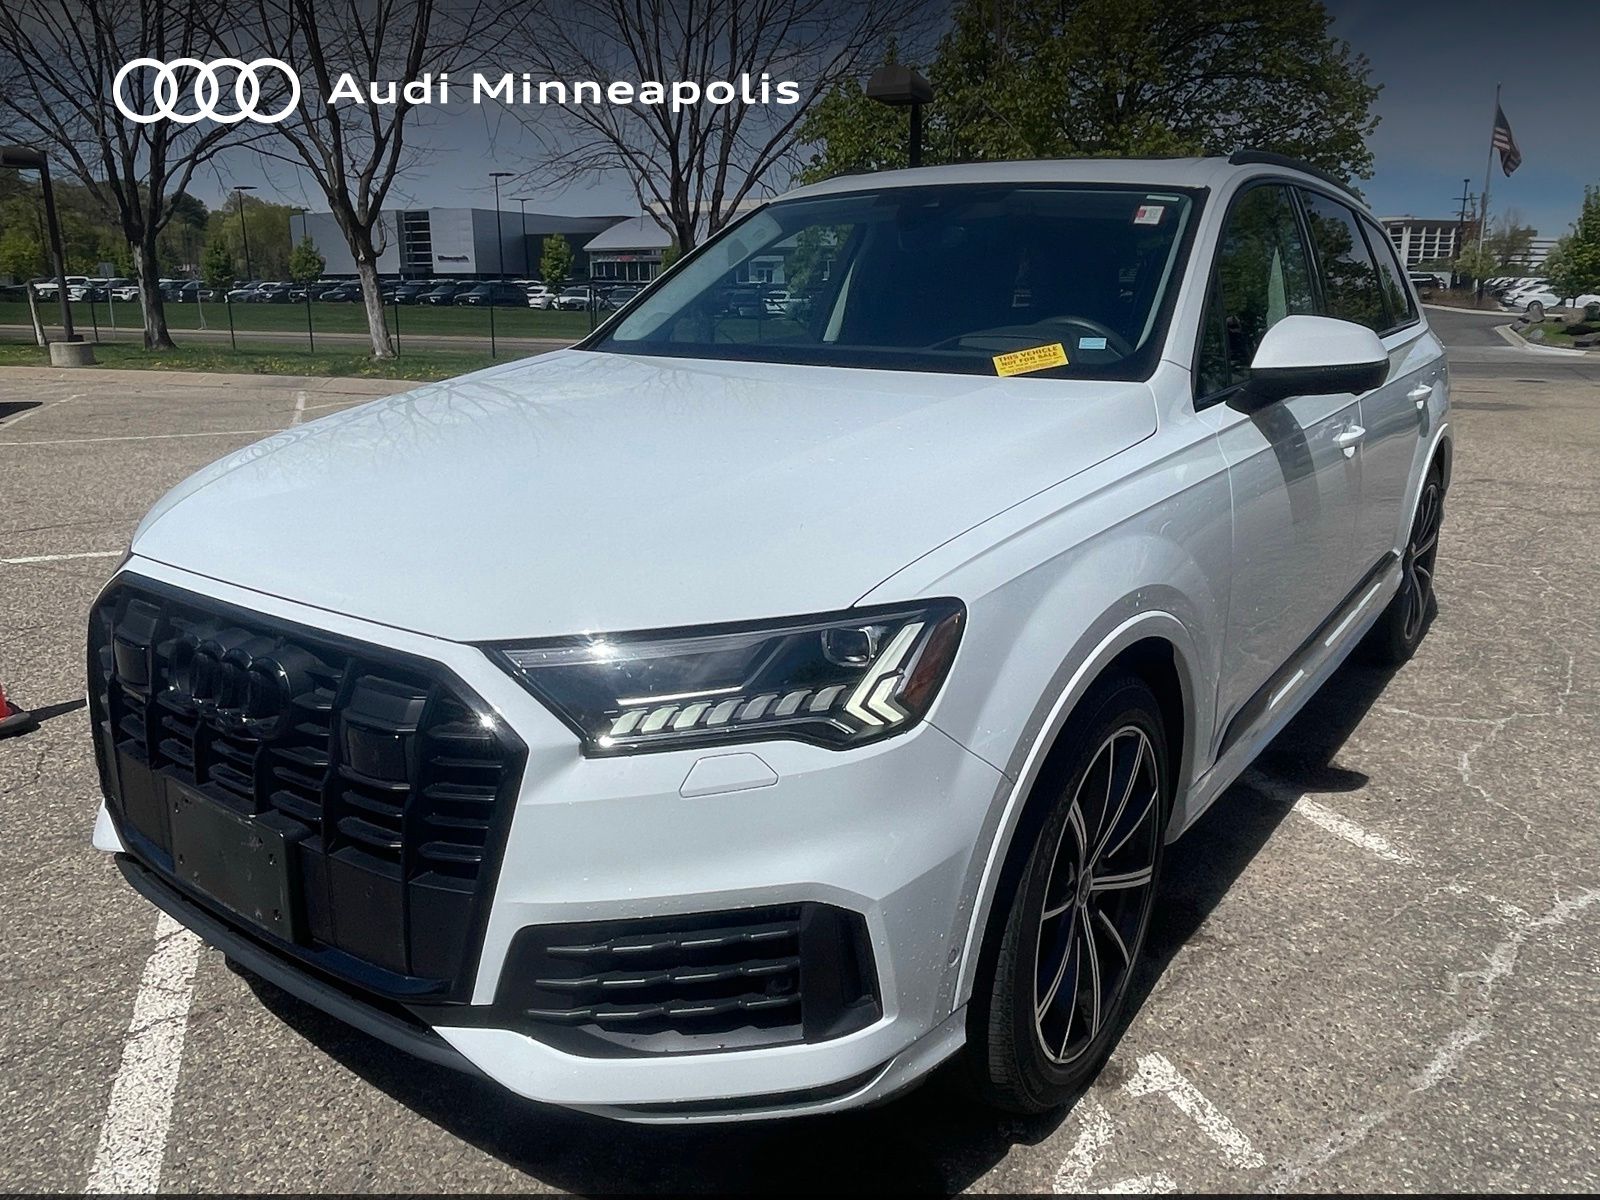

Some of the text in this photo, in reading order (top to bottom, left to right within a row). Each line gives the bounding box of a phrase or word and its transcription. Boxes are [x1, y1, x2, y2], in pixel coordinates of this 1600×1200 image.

[998, 345, 1058, 363] THIS VEHICLE
[1001, 359, 1017, 367] NOT
[1038, 351, 1058, 359] SALE
